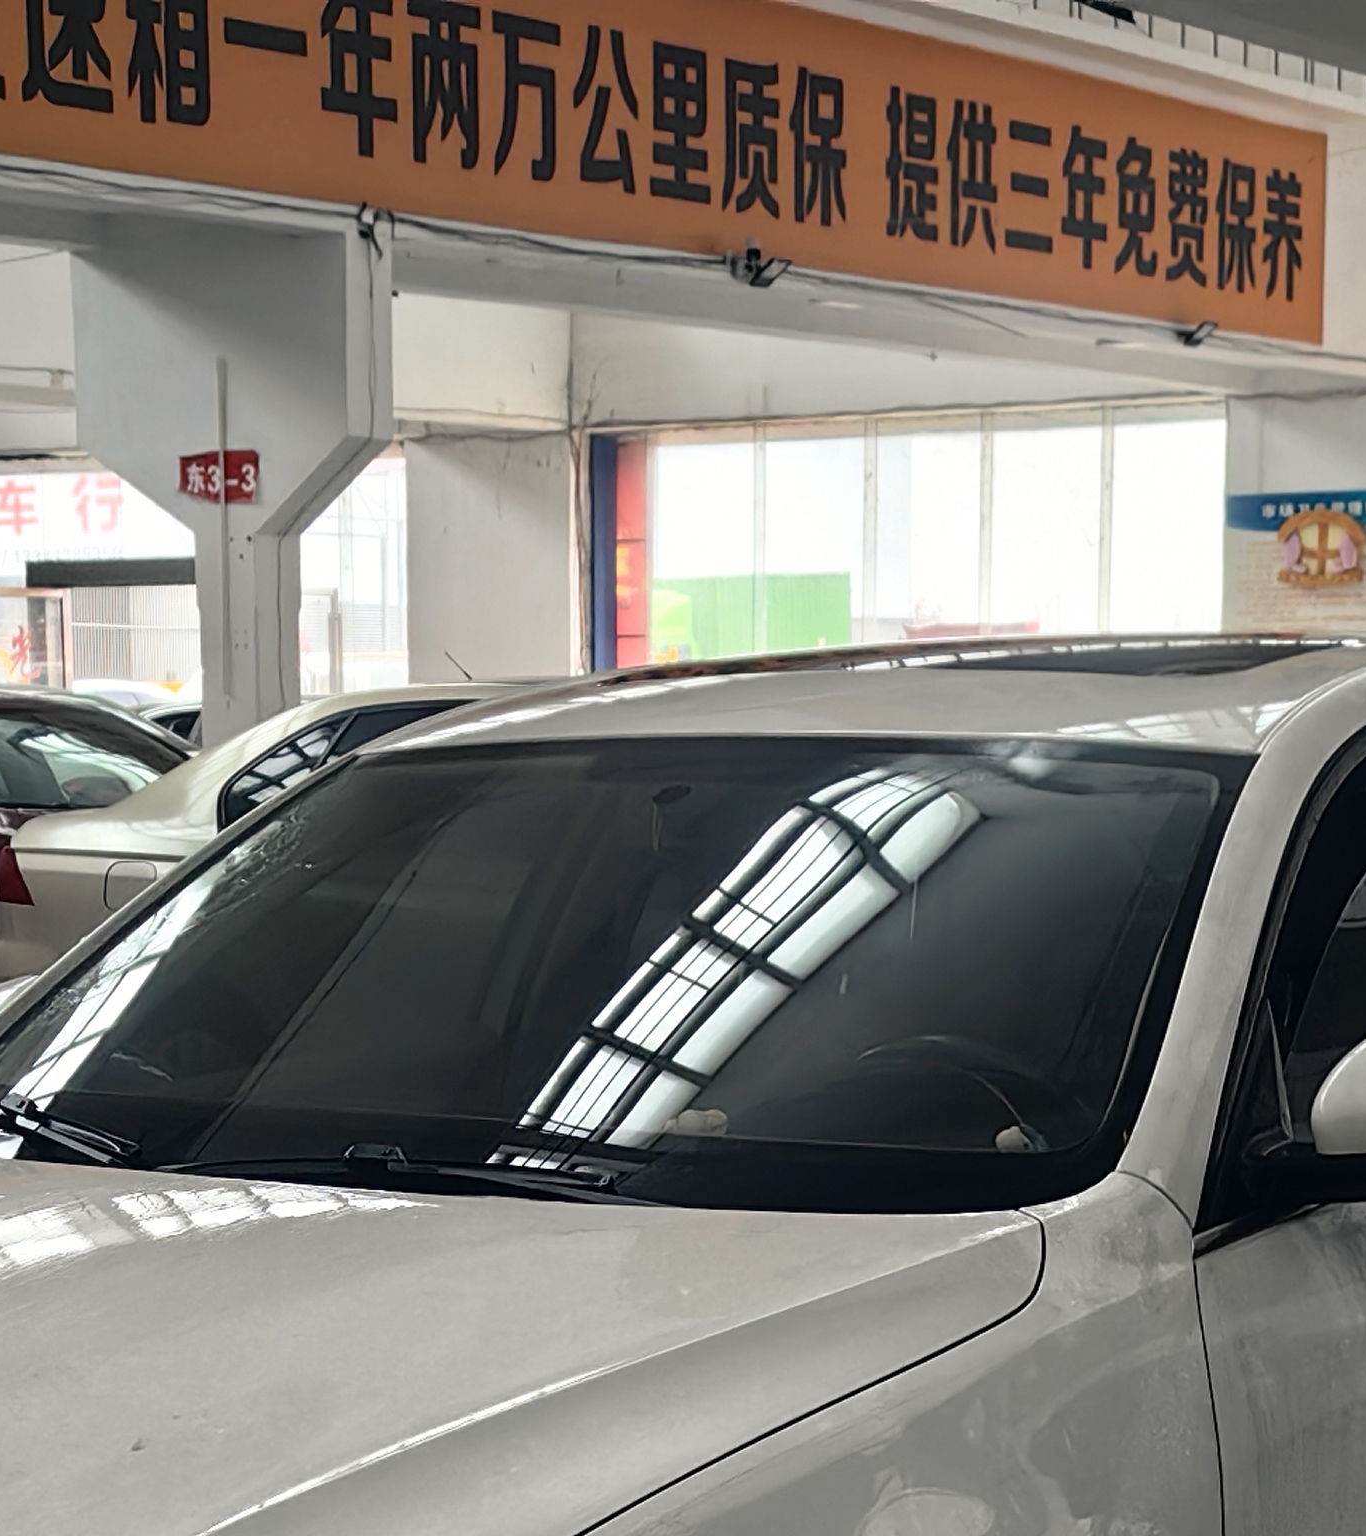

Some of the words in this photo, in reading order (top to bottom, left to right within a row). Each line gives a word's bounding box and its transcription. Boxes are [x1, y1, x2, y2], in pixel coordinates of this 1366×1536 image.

[885, 85, 1304, 301] 提供三年免费保养
[186, 461, 256, 493] 东3-3
